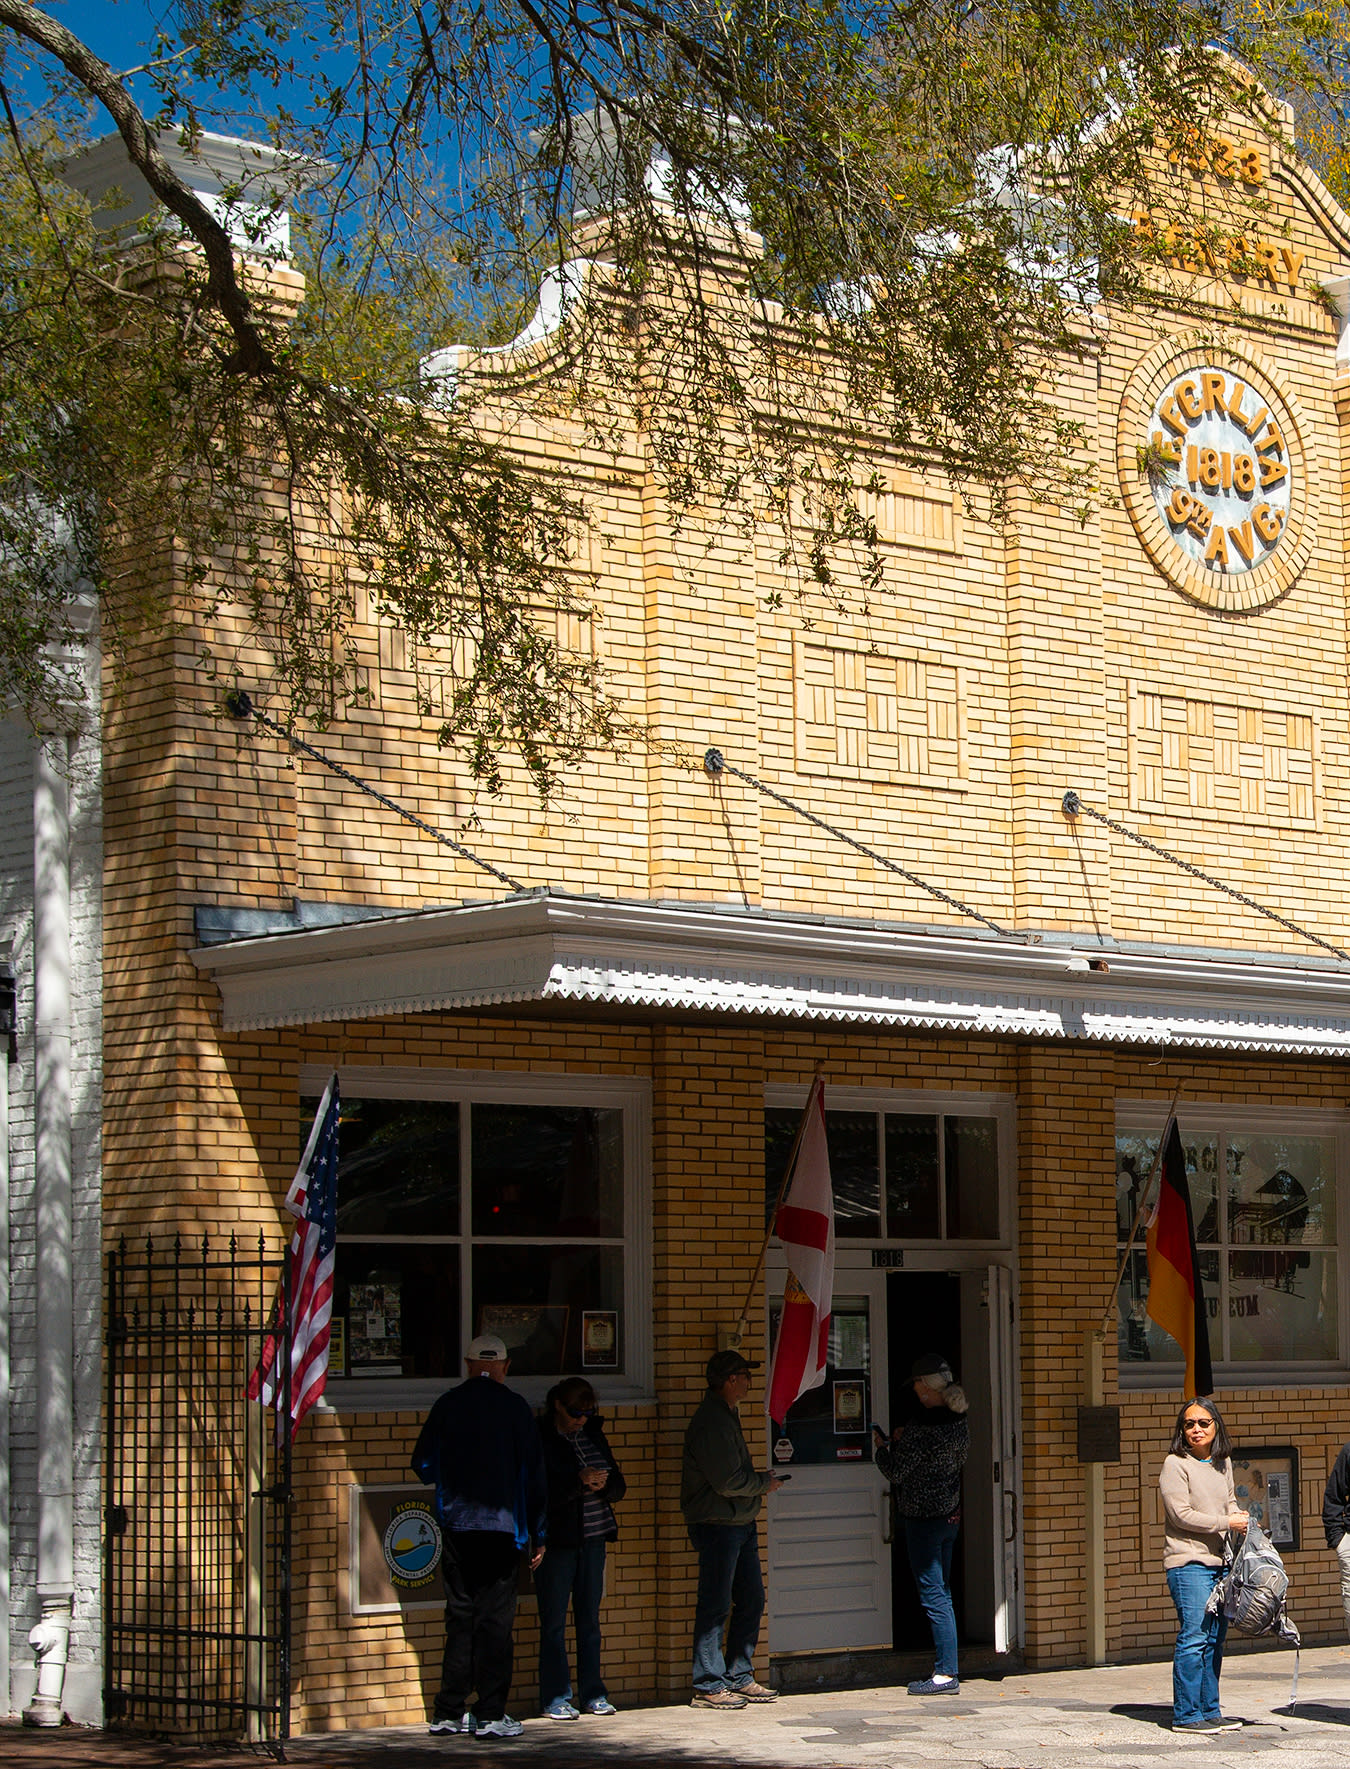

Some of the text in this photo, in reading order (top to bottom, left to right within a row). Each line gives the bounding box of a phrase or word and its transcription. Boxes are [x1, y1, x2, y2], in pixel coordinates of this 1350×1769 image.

[1186, 445, 1256, 493] 1818
[873, 1251, 903, 1267] 1818
[395, 1501, 431, 1513] FLORIDA
[391, 1573, 435, 1587] PARK SERVICE
